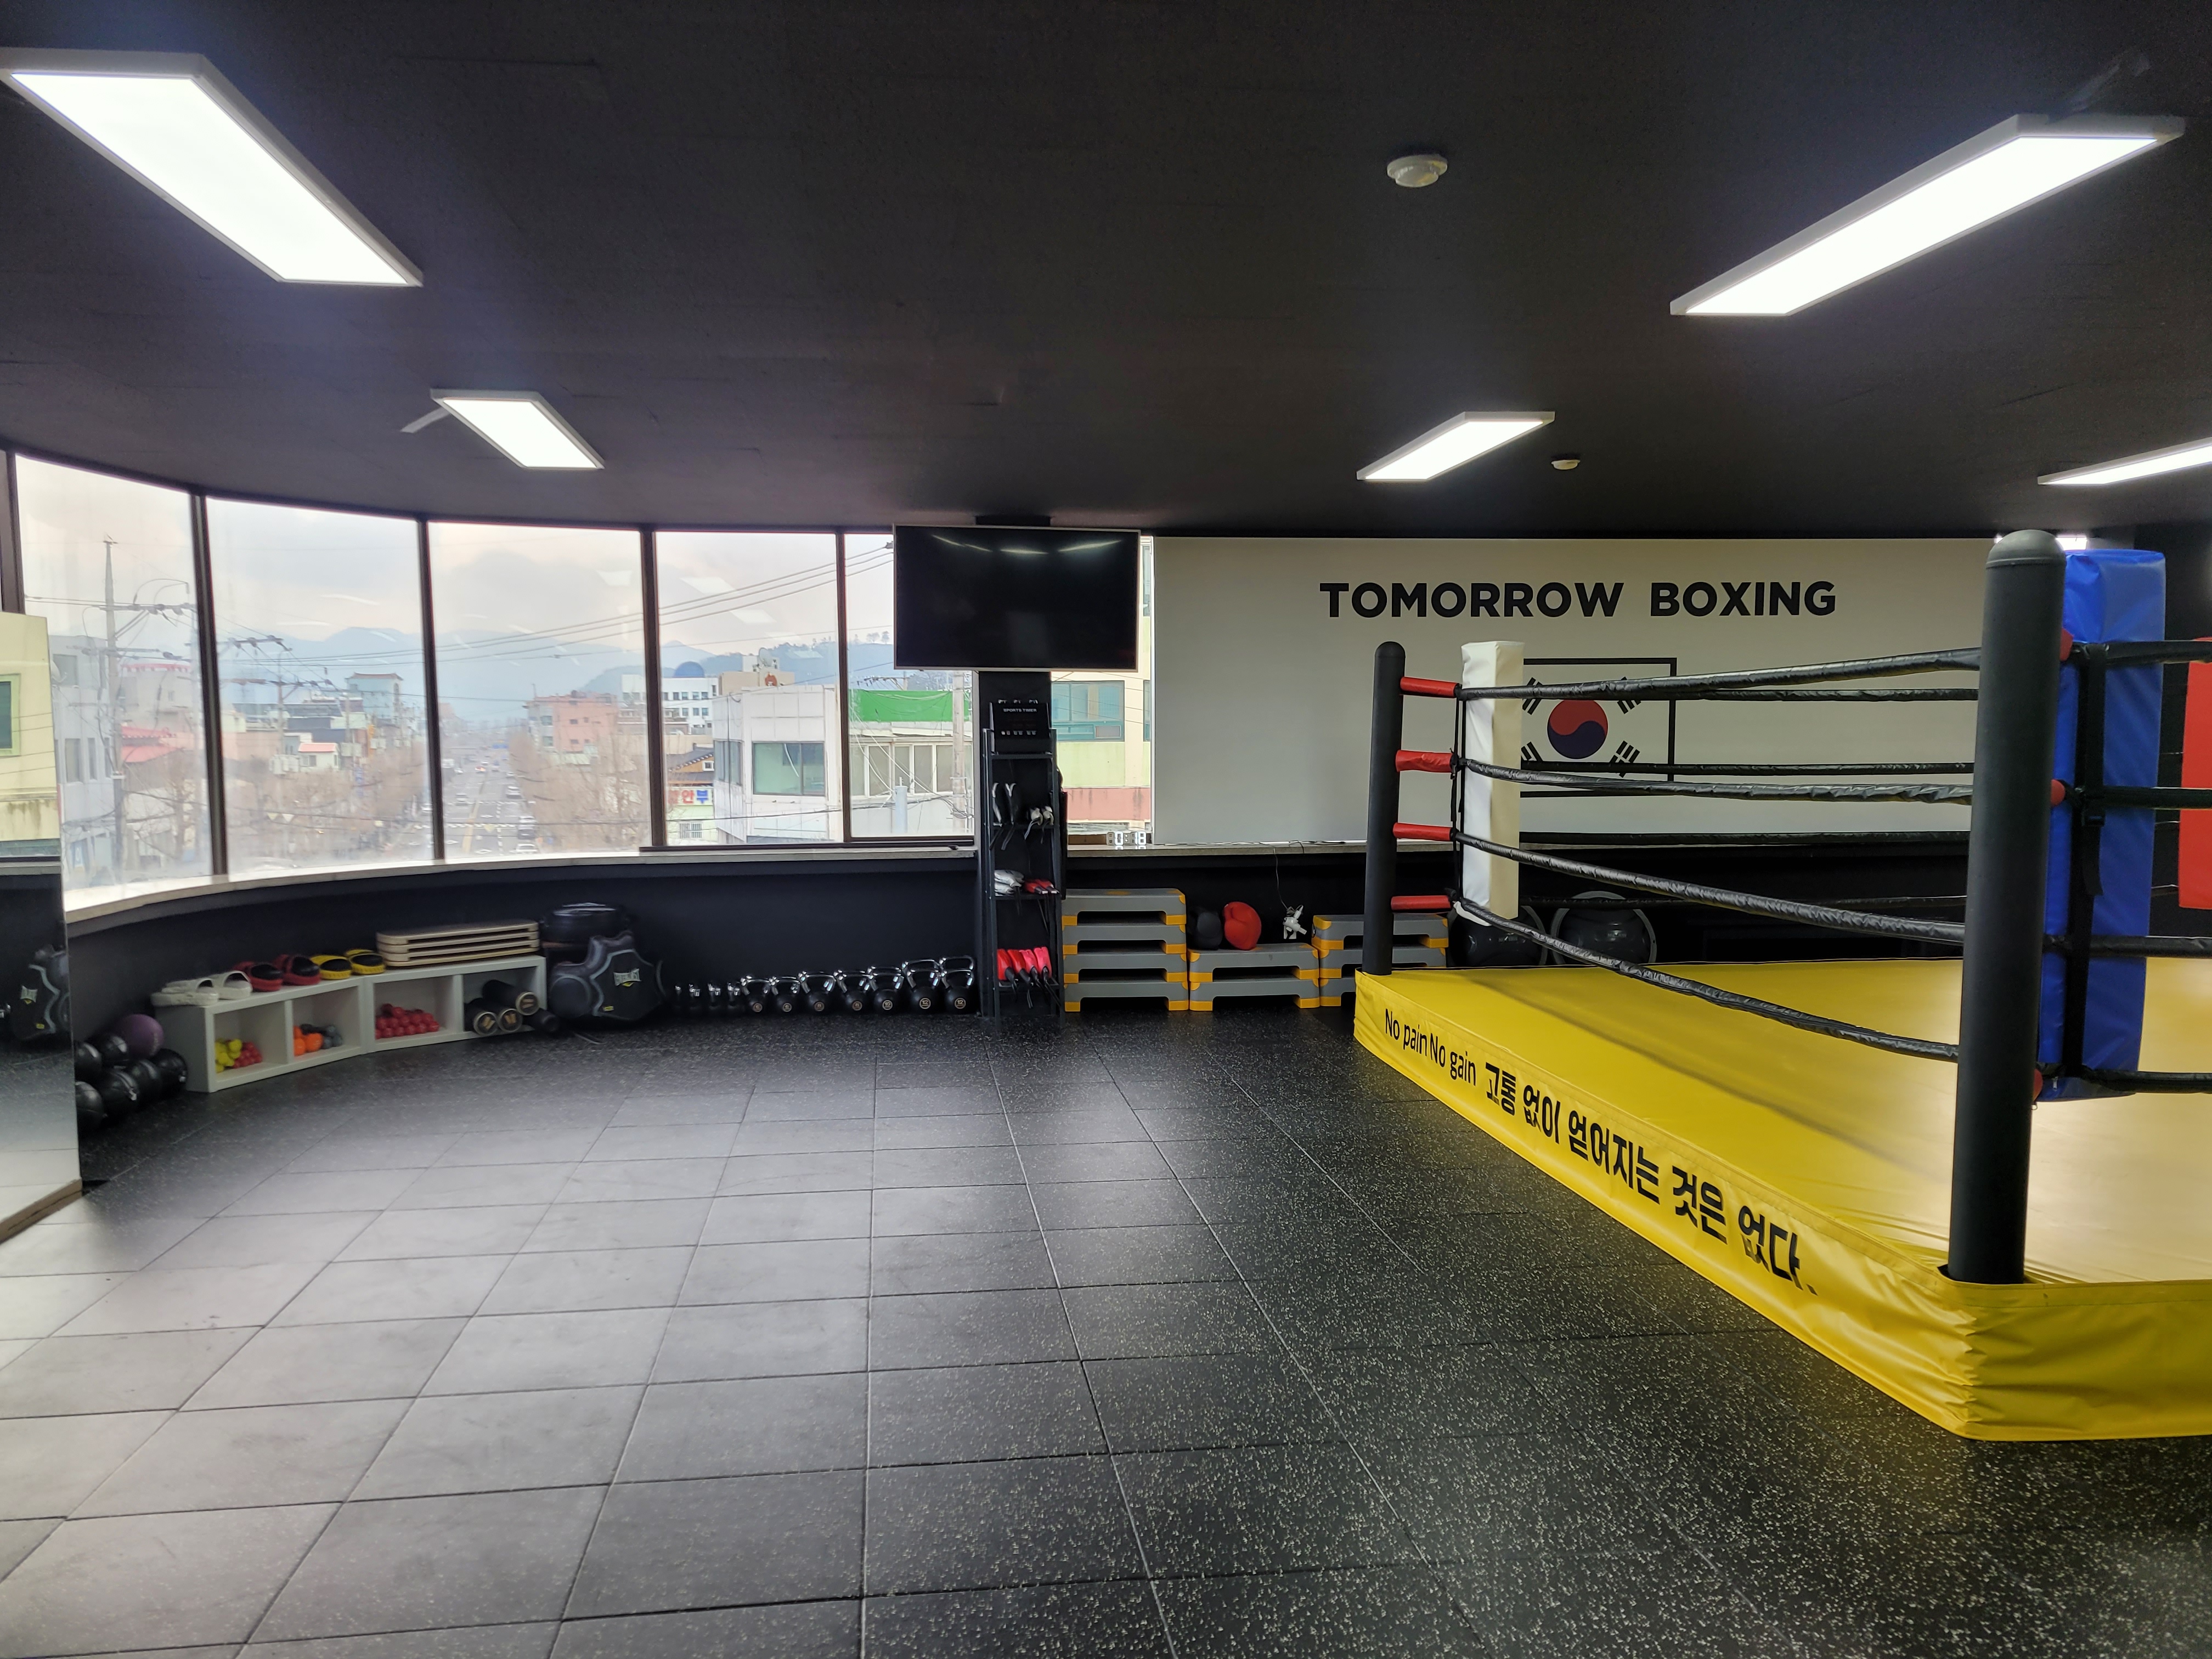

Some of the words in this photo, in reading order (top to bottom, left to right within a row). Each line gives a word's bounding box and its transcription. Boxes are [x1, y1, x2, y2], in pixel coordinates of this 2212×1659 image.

[1319, 582, 1624, 618] TOMORROW
[1650, 580, 1836, 617] BOXING
[1385, 1008, 1401, 1041] No
[1403, 1024, 1427, 1057] pain
[1430, 1032, 1446, 1068] No
[1450, 1051, 1477, 1086] gain
[1485, 1062, 1516, 1116] 고통
[1523, 1085, 1561, 1144] 없이
[1568, 1110, 1661, 1205] 얻어지는
[1672, 1165, 1728, 1245] 것은
